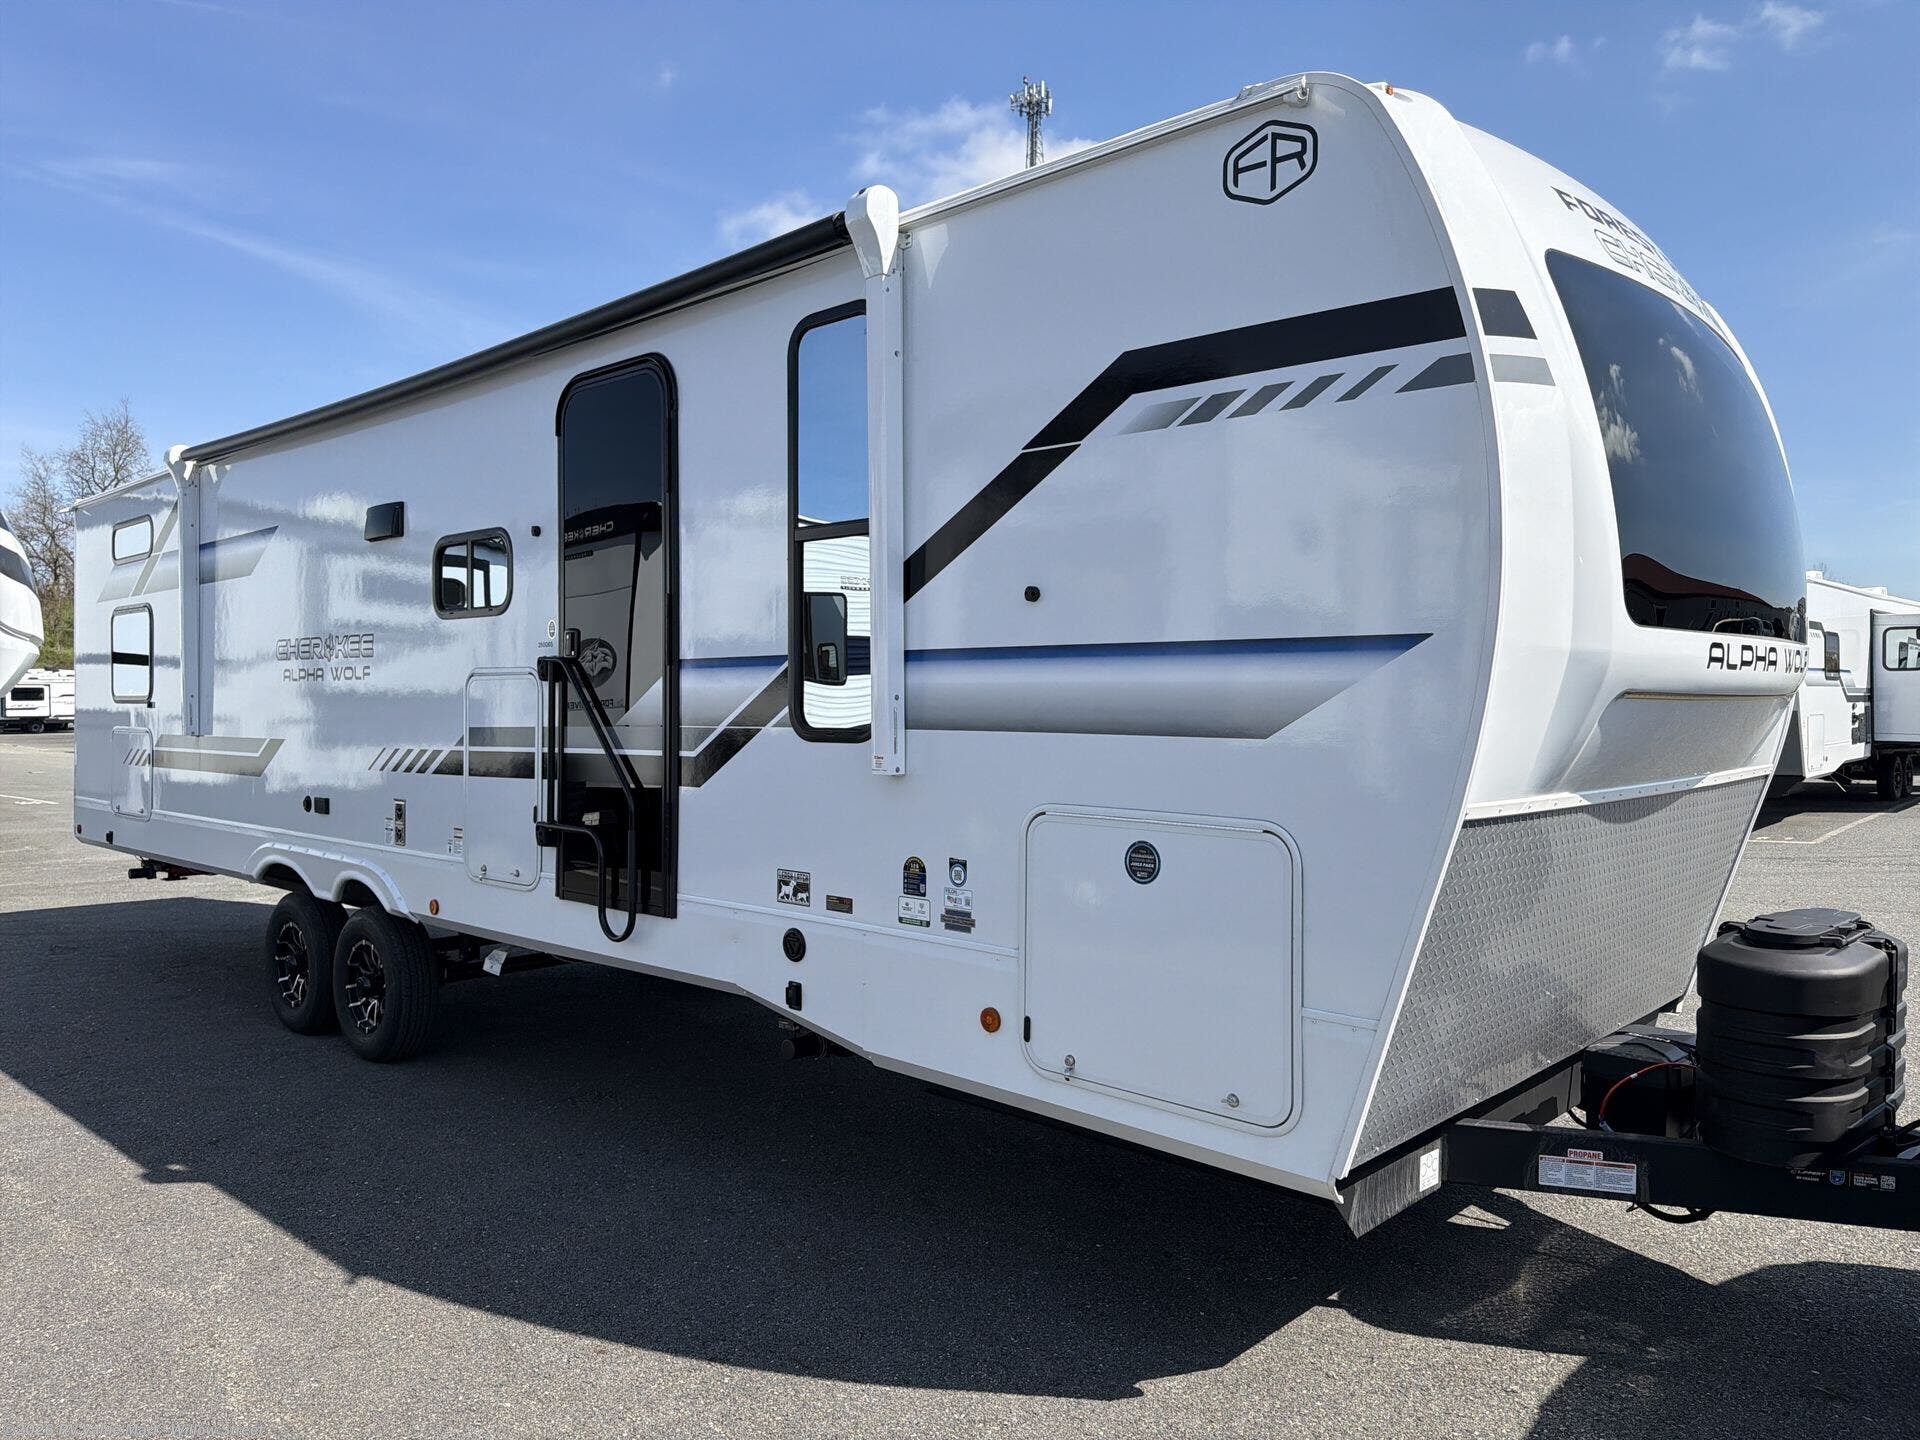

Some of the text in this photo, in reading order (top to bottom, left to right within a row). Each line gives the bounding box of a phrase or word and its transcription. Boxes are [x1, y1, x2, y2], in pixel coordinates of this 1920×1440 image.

[1706, 642, 1778, 673] ALPHA
[283, 665, 371, 682] ALPHA WOLF
[1568, 1149, 1603, 1160] PROPANE
